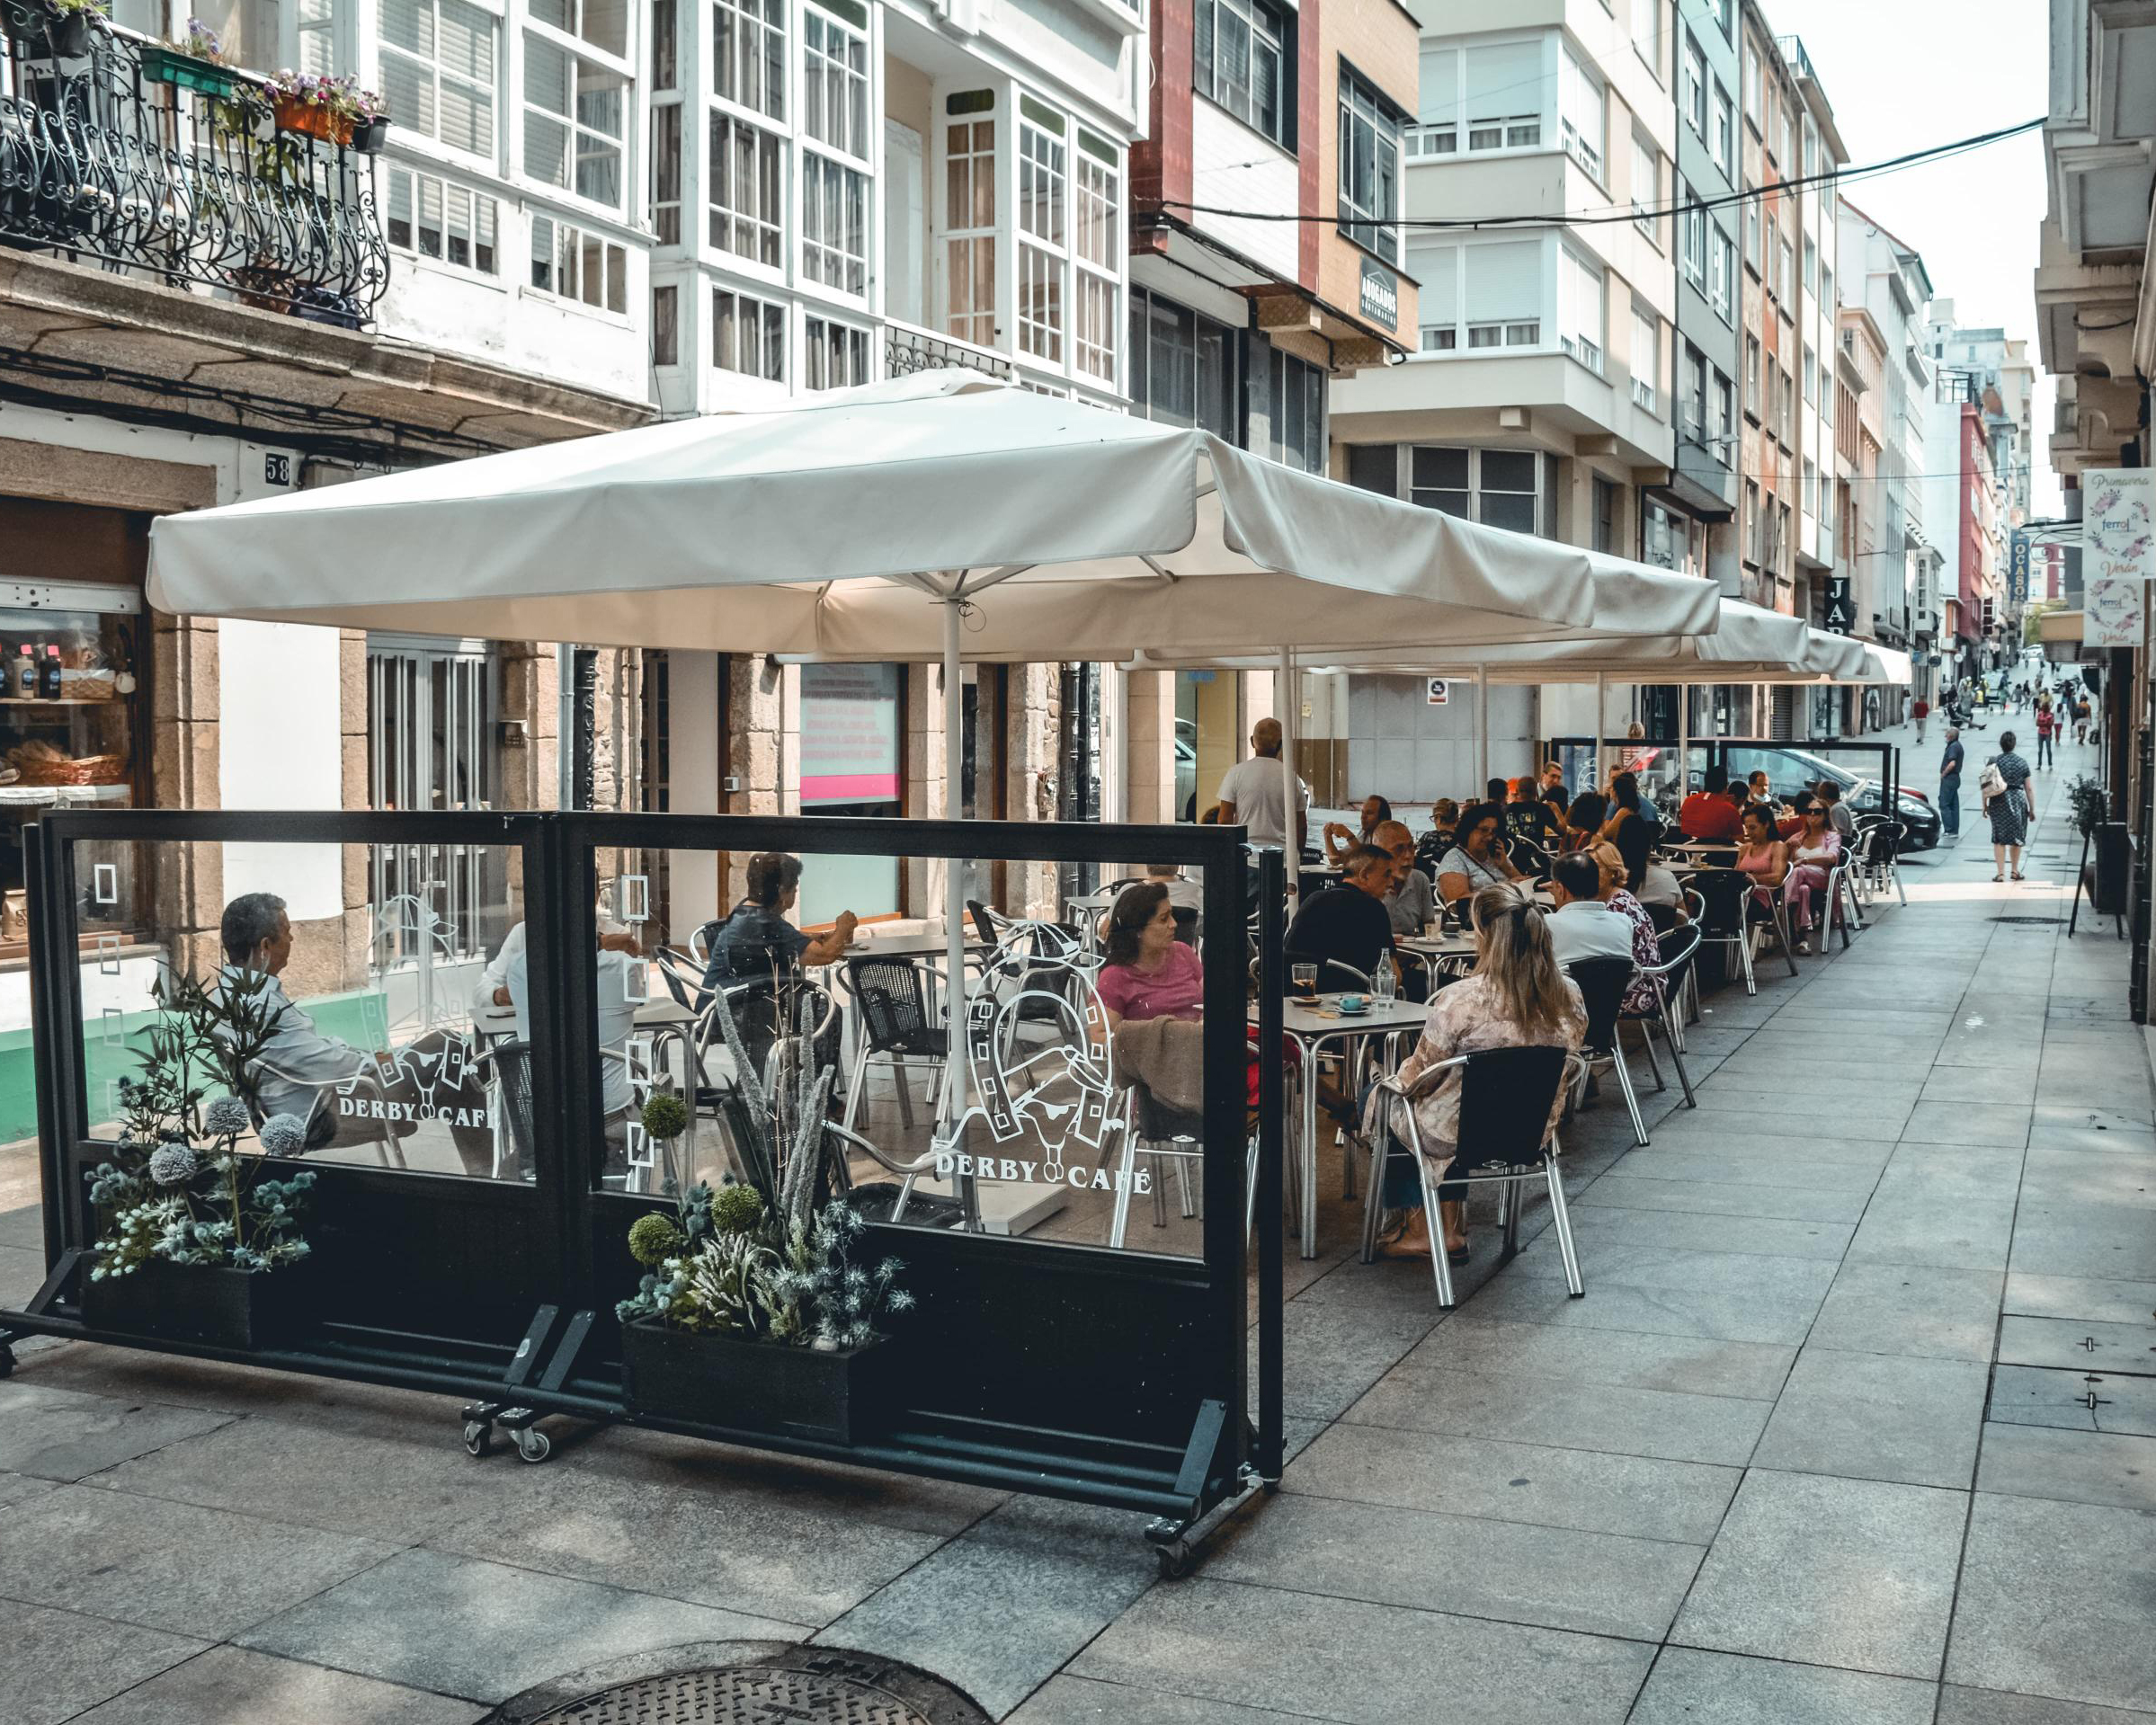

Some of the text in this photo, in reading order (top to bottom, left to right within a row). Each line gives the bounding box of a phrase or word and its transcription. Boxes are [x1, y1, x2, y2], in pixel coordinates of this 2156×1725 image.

[1361, 276, 1396, 314] ABOGADOS
[267, 457, 289, 482] 58
[2091, 474, 2150, 490] Primavera
[2102, 518, 2130, 533] ferrol
[2014, 543, 2027, 596] OCASO
[339, 1097, 416, 1122] DERBY
[936, 1151, 1152, 1195] DERBY CAFÉ
